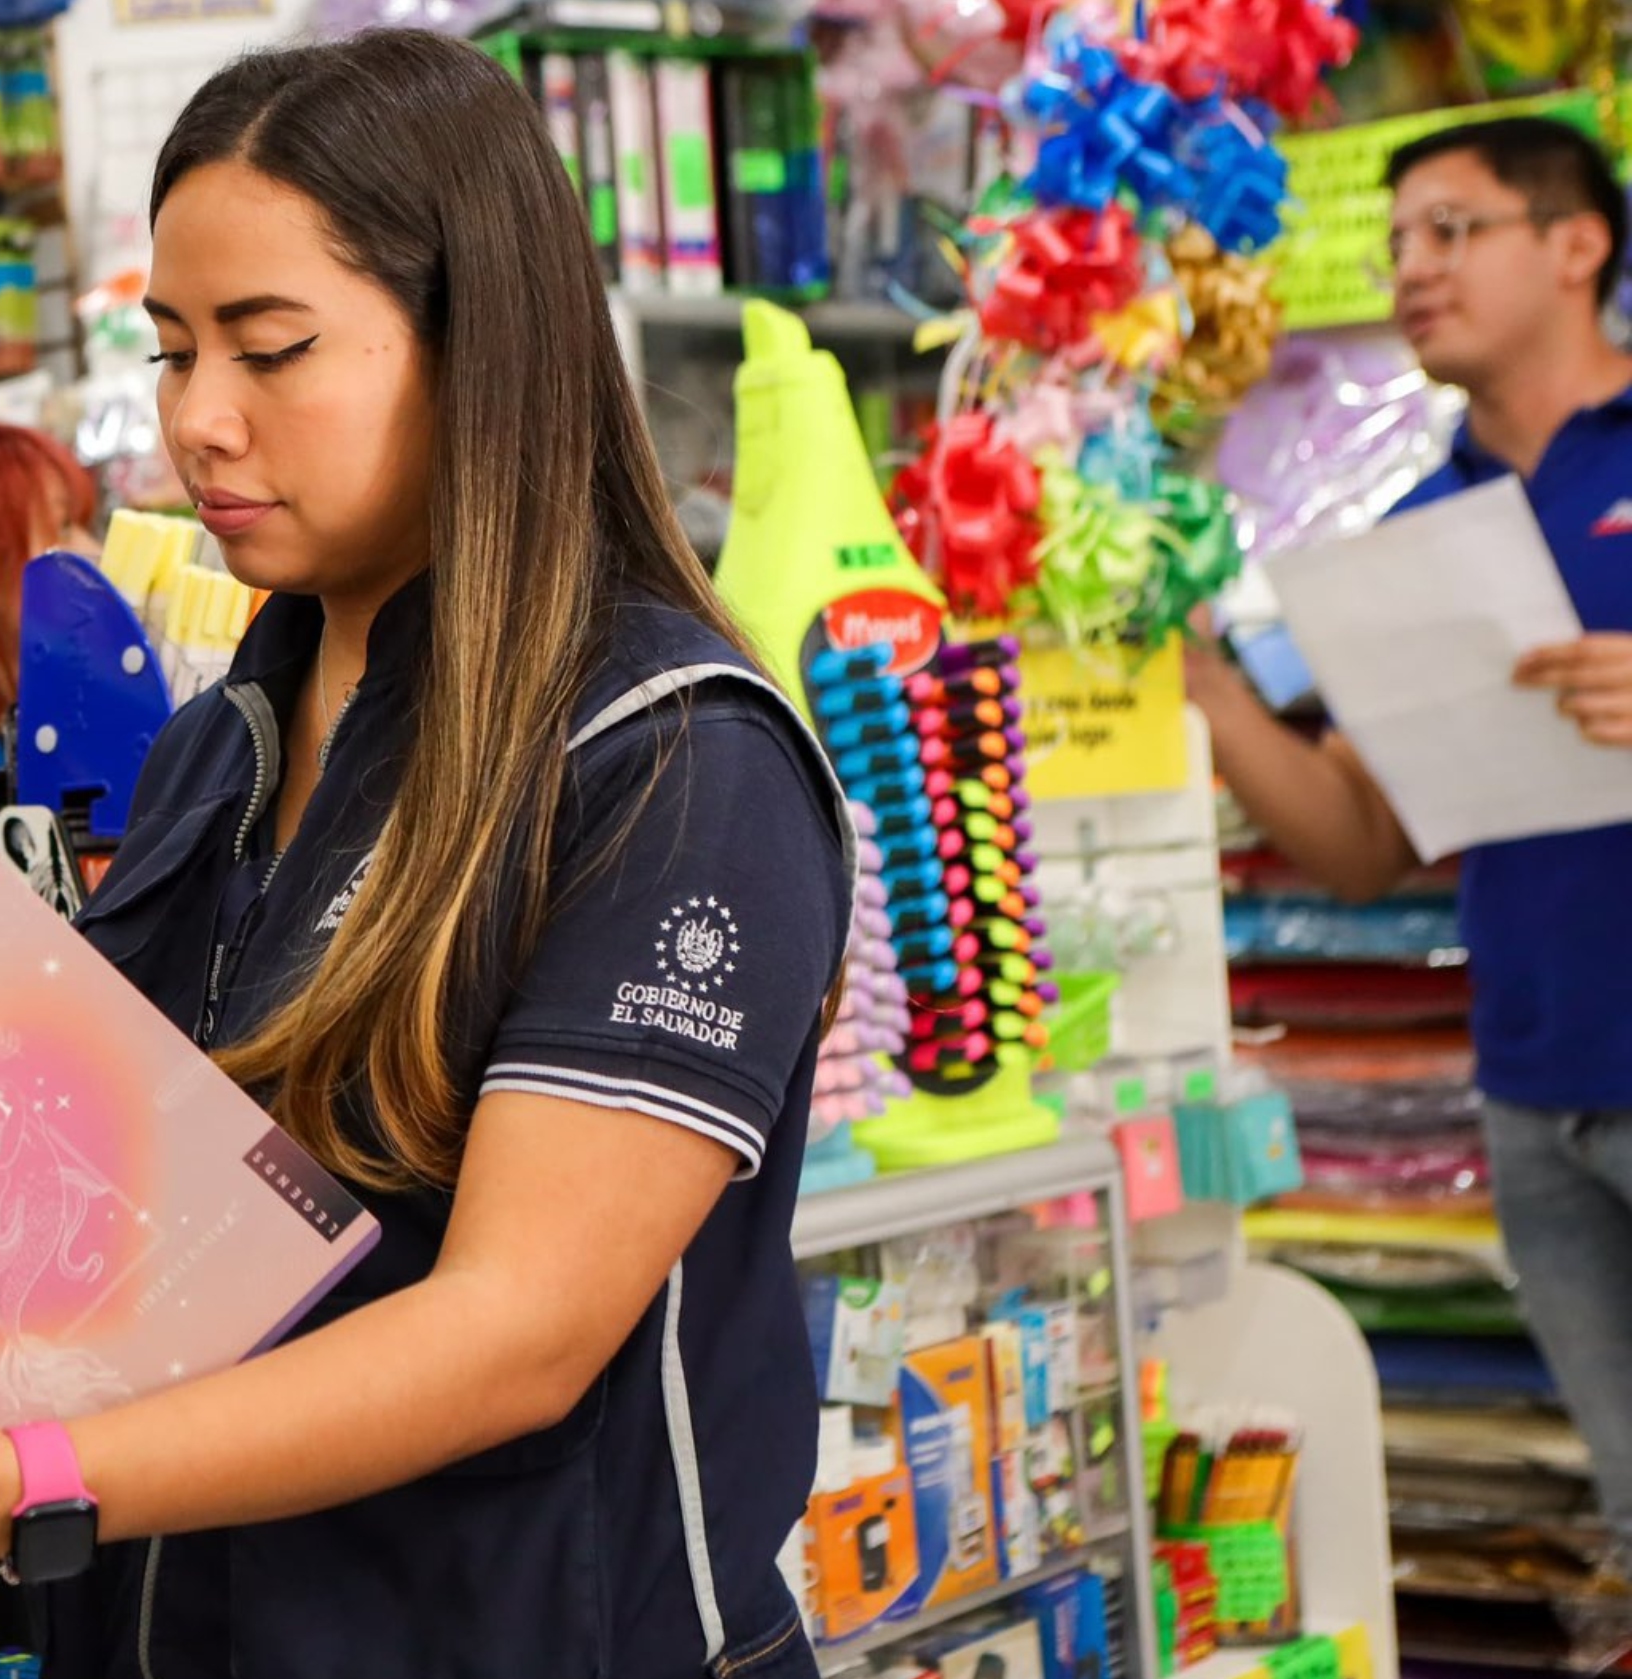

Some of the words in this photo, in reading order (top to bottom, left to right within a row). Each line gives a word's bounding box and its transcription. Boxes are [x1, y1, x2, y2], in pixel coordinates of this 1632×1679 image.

[842, 612, 923, 650] Maped
[609, 1002, 636, 1023] EL
[640, 1007, 738, 1050] SALVADOR
[617, 981, 716, 1021] GOBIERNO
[718, 1006, 745, 1031] DE
[251, 1150, 340, 1236] LEGENDS
